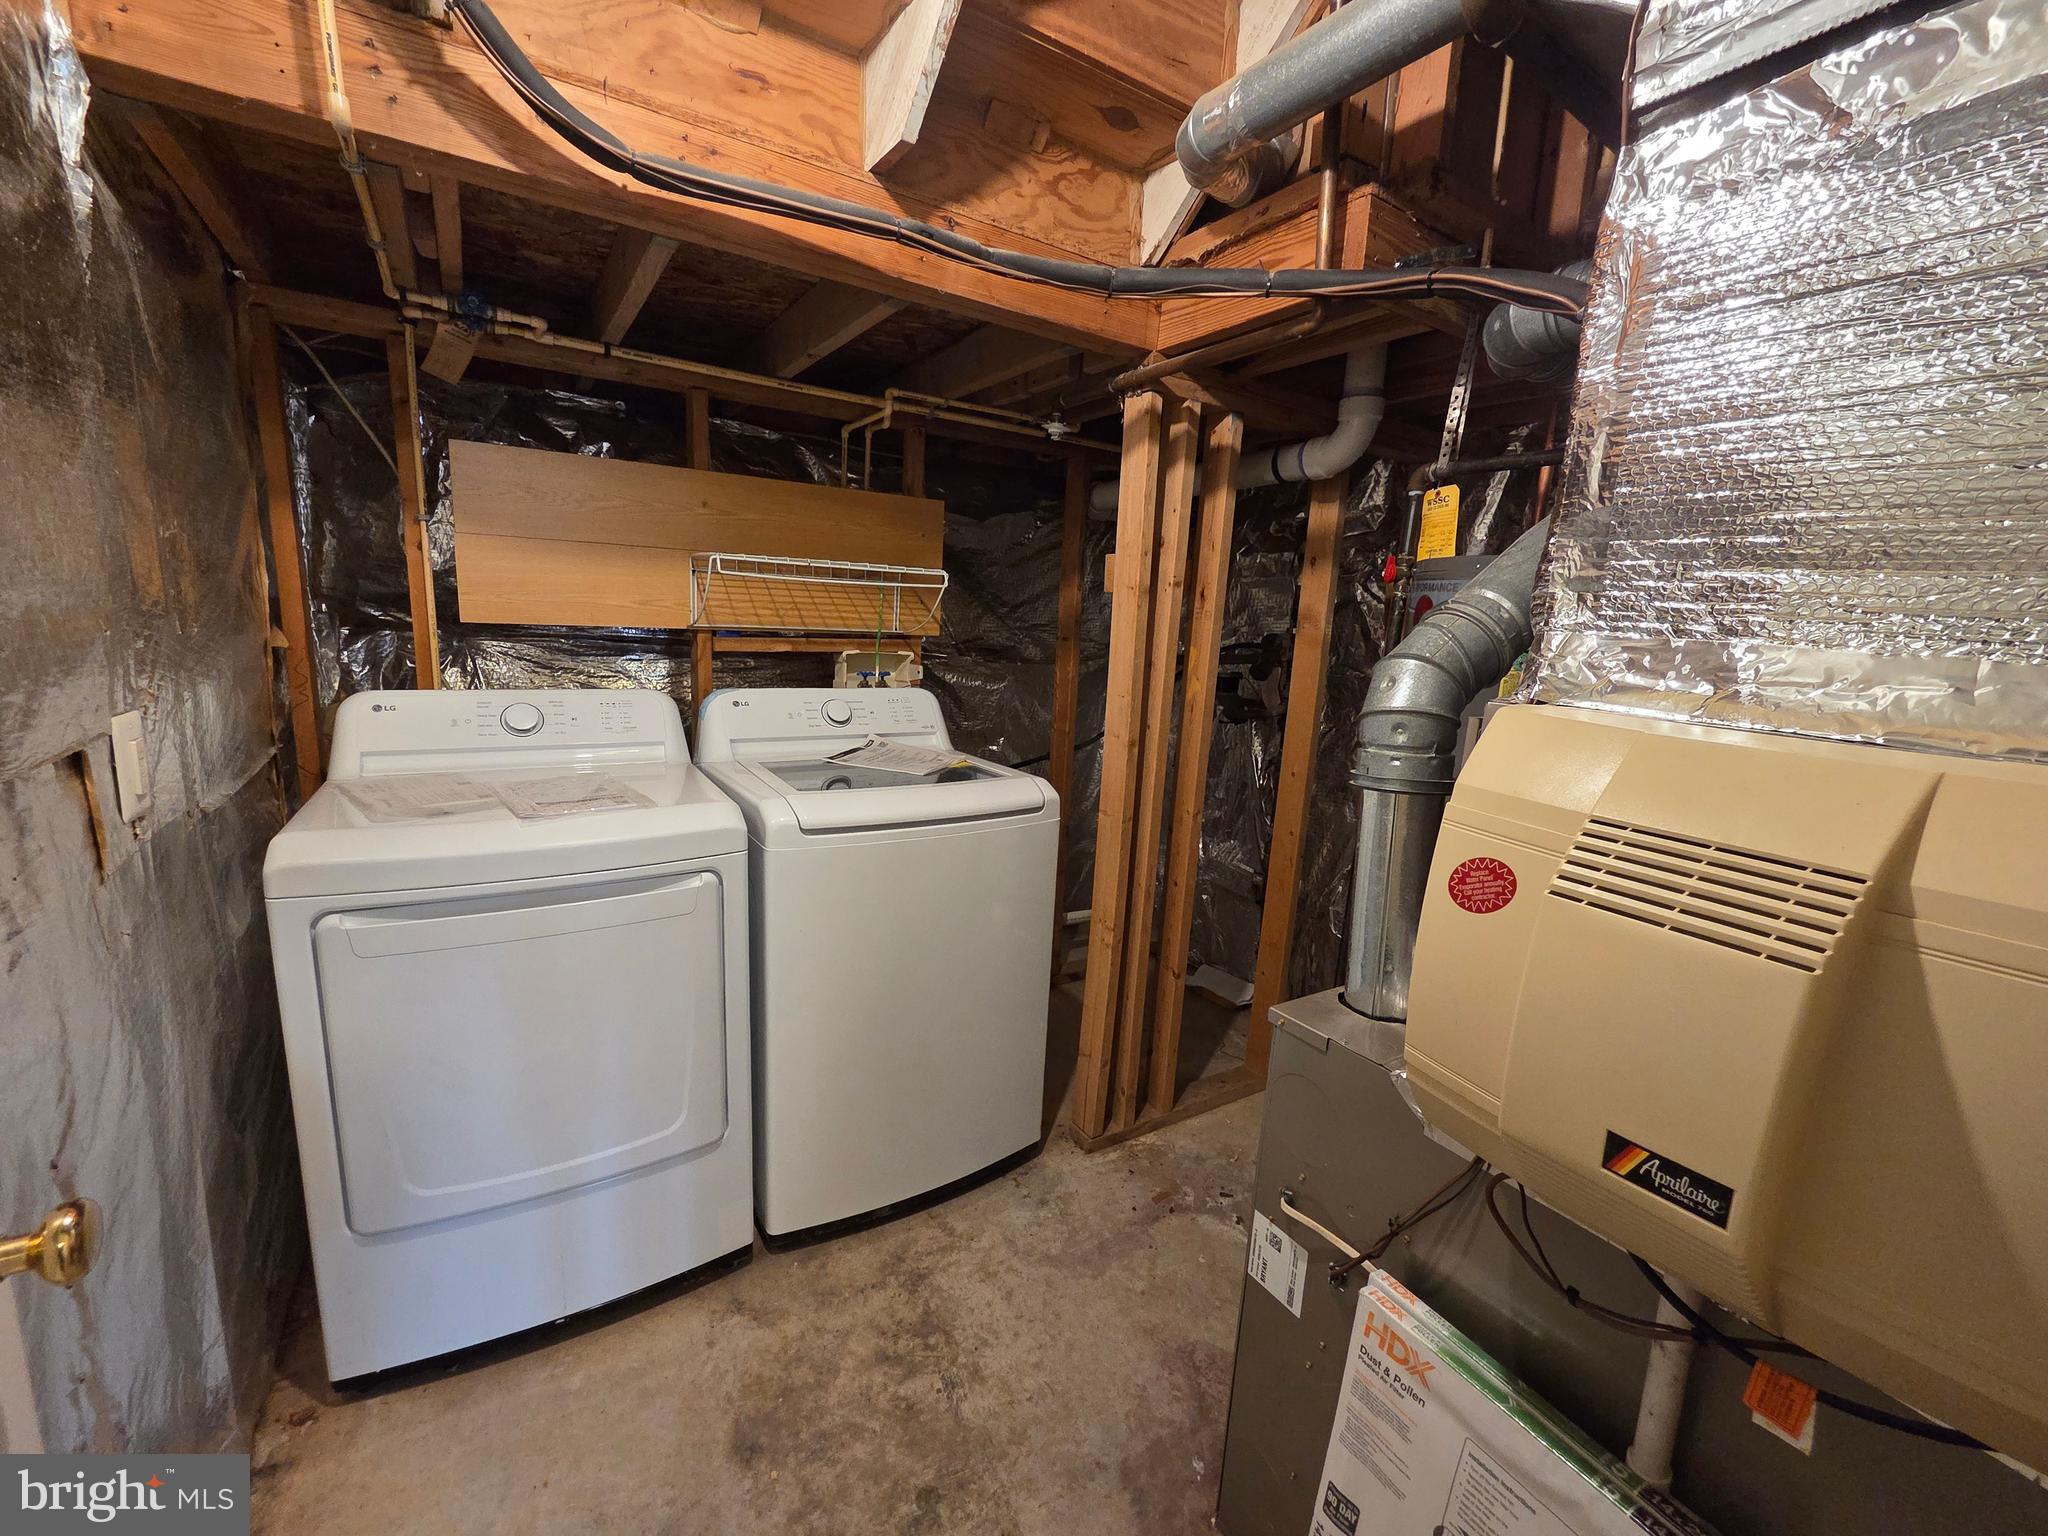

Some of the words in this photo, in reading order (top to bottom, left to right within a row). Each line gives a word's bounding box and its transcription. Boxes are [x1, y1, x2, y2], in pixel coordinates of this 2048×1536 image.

[1427, 495, 1450, 506] WSSC
[1640, 1159, 1721, 1212] Aprilaire
[1662, 1188, 1695, 1207] MODEL
[1368, 1288, 1406, 1321] HDX
[1363, 1311, 1436, 1392] HDX
[1360, 1344, 1381, 1370] Dust
[1383, 1367, 1391, 1378] &
[1393, 1374, 1426, 1408] Pollen
[1380, 1375, 1388, 1384] Air
[1327, 1490, 1338, 1507] 90
[1339, 1503, 1357, 1523] DAY
